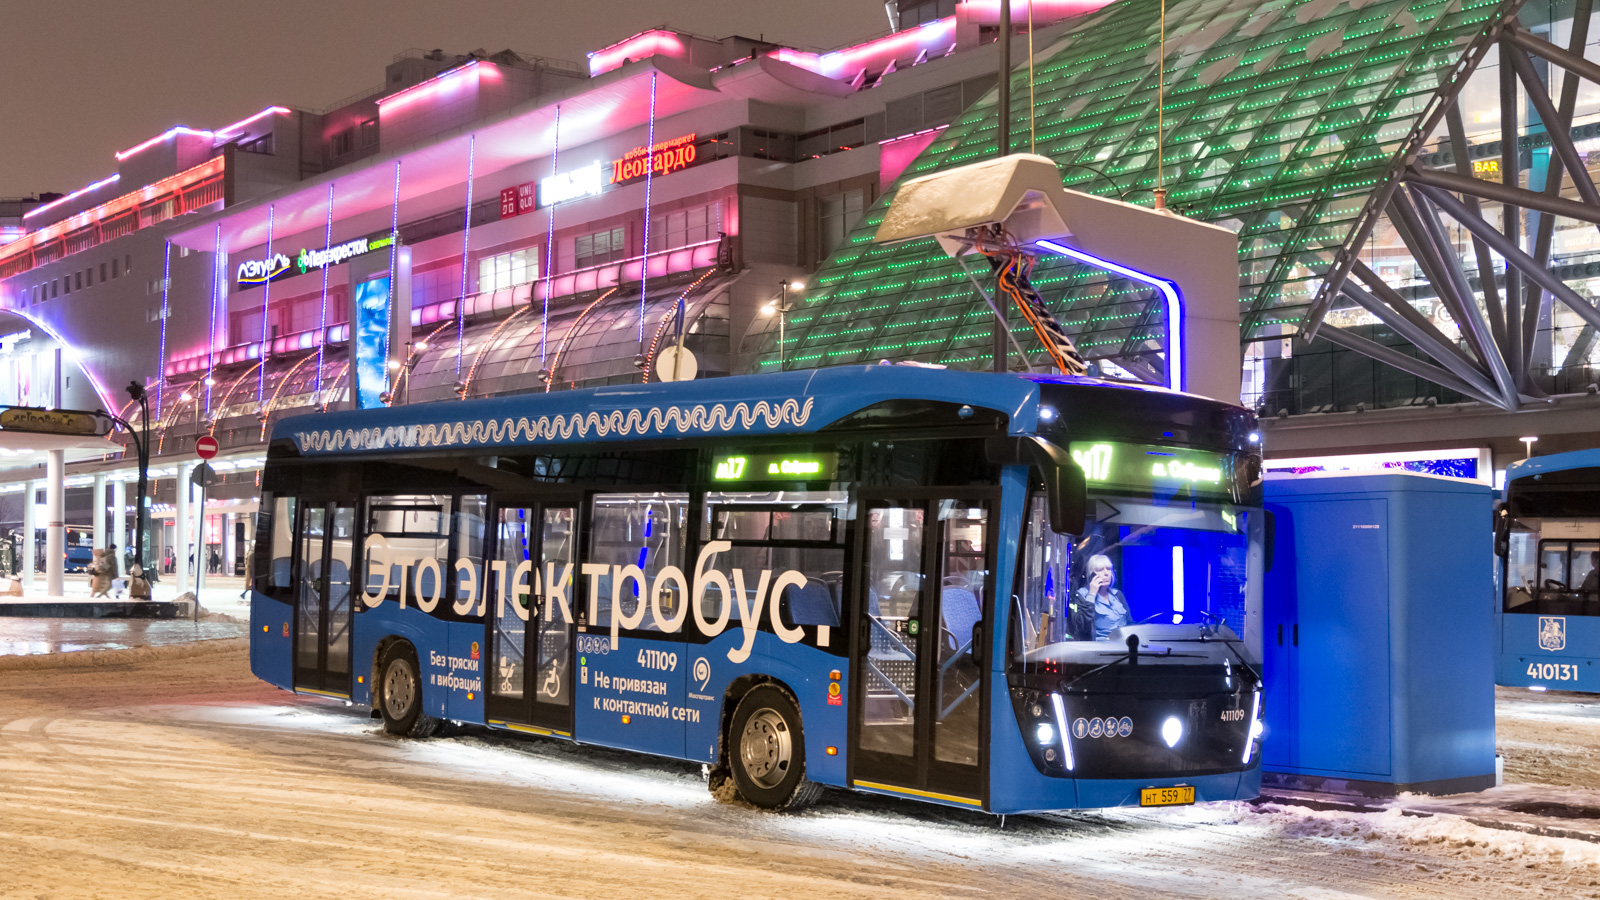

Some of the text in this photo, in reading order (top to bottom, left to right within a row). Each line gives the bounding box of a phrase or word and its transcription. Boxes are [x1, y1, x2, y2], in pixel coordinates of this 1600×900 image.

[624, 132, 696, 161] хобби-ипермаркет
[609, 144, 696, 184] Леонардо
[1473, 161, 1499, 173] BAR
[519, 183, 532, 197] UNI
[519, 196, 533, 211] QLO
[361, 533, 830, 665] Это электробус.
[430, 650, 478, 672] Без тряски
[637, 648, 677, 672] 411109
[430, 672, 481, 692] и вибраций
[1526, 663, 1578, 681] 410131
[594, 671, 667, 695] Не привязан
[593, 697, 700, 723] к контактной сети
[1220, 709, 1245, 722] 411109
[1145, 793, 1157, 804] НТ
[1161, 790, 1178, 803] 559
[1183, 788, 1192, 798] 77
